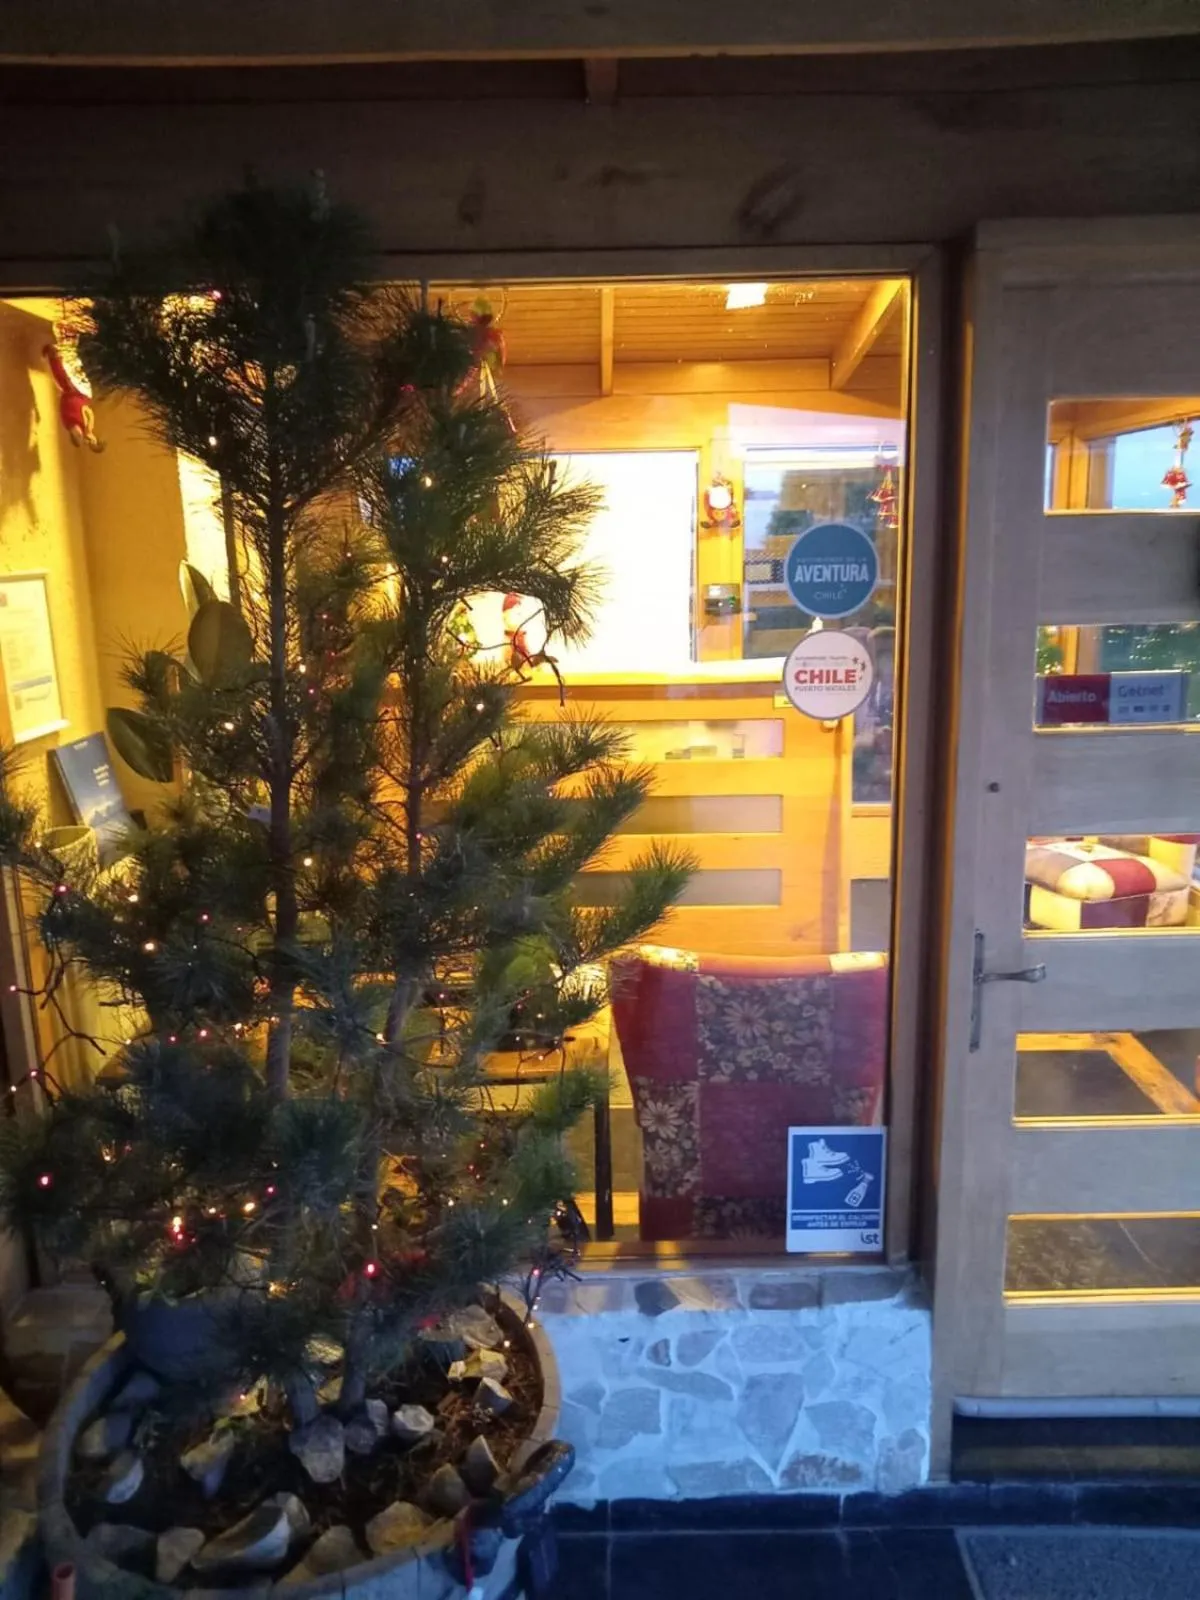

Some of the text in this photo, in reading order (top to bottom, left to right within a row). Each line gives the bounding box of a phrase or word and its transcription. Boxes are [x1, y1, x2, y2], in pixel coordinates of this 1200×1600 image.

[794, 564, 869, 583] AVENTURA
[814, 591, 844, 600] CHILE
[794, 669, 857, 684] CHILE
[1046, 690, 1097, 704] Abierto
[1118, 684, 1165, 698] Getnet
